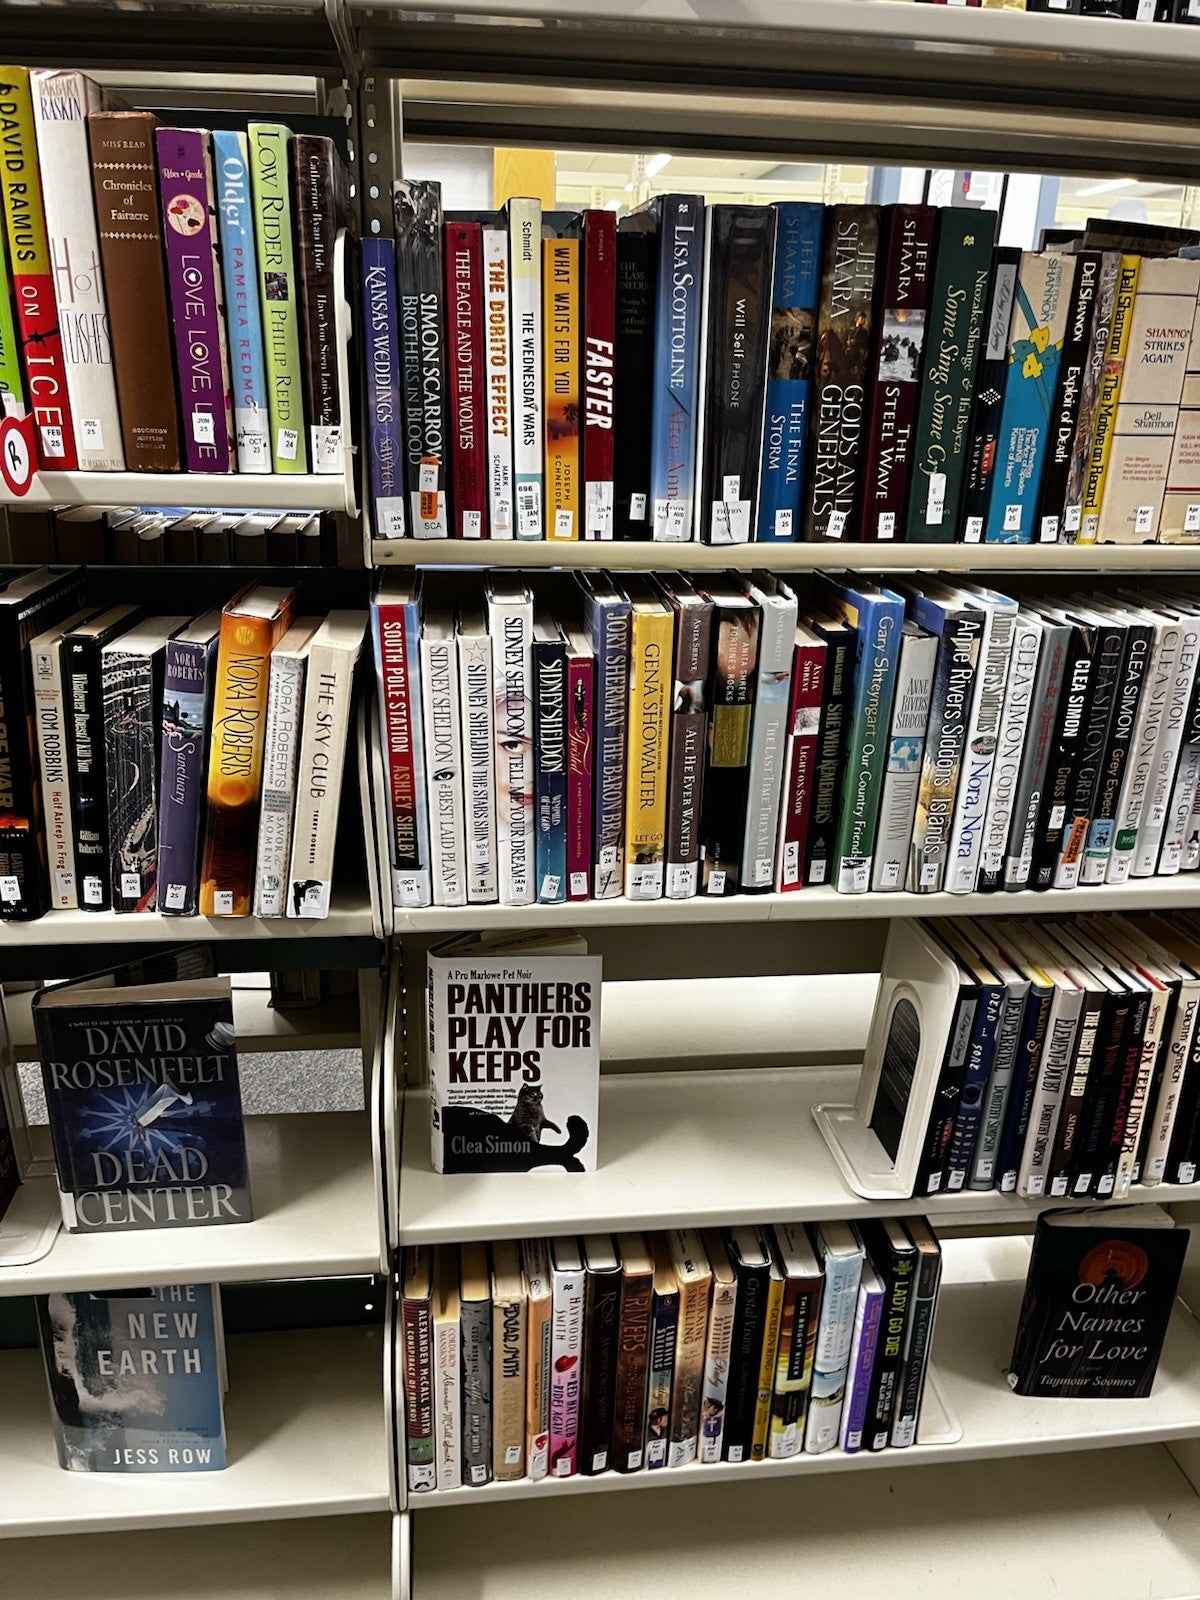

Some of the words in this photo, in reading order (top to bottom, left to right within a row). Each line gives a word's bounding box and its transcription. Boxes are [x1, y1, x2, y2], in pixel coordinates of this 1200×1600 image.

[1, 102, 25, 172] DAVID
[124, 141, 146, 149] READ
[257, 132, 279, 187] LOW
[103, 180, 152, 191] Chronicles
[223, 158, 245, 235] Older
[9, 183, 35, 261] RAMUS
[110, 210, 149, 221] Fairacre
[262, 196, 284, 265] RIDER
[455, 249, 470, 278] THE
[554, 247, 570, 284] WHAT
[674, 225, 694, 269] LISA
[897, 220, 916, 301] SHAARA
[489, 259, 506, 293] THE
[830, 222, 859, 318] SHAARA
[365, 266, 388, 331] KANSAS
[455, 282, 472, 328] EAGLE
[554, 292, 570, 333] WAITS
[271, 310, 287, 367] PHILIP
[489, 301, 507, 367] DORITO
[522, 312, 534, 334] THE
[671, 273, 694, 388] SCOTTOLINE
[457, 332, 473, 362] AND
[554, 340, 570, 363] FOR
[1141, 353, 1173, 363] AGAIN
[1143, 341, 1185, 351] STRIKES
[373, 335, 393, 423] WEDDINGS
[458, 365, 473, 393] THE
[522, 338, 535, 410] WEDNESDAY
[555, 371, 570, 394] YOU
[585, 336, 614, 430] FASTER
[275, 375, 291, 421] REED
[491, 374, 508, 437] EFFECT
[789, 400, 804, 433] THE
[881, 387, 900, 441] STEEL
[459, 395, 474, 450] WOLVES
[523, 413, 535, 446] WARS
[768, 415, 785, 470] STORM
[786, 439, 801, 484] FINAL
[812, 385, 843, 516] GENERALS
[894, 424, 911, 462] THE
[493, 455, 501, 497] SCHATZKER
[875, 447, 894, 499] WAVE
[424, 522, 442, 530] SCA
[174, 652, 196, 667] NORA
[383, 622, 403, 663] SOUTH
[953, 619, 981, 663] Anne
[1014, 633, 1037, 687] CLEA
[1126, 640, 1147, 682] CLEA
[1155, 631, 1178, 685] CLEA
[1178, 632, 1198, 673] CLEA
[168, 664, 203, 680] ROBERTS
[226, 652, 264, 700] NORA
[318, 673, 336, 705] THE
[386, 667, 405, 698] POLE
[430, 646, 451, 696] SIDNEY
[644, 644, 660, 697] GENA
[907, 678, 929, 694] ANNE
[1071, 660, 1091, 692] CLEA
[280, 672, 296, 715] NORA
[901, 695, 928, 712] RIVERS
[944, 668, 973, 720] Rivers
[1115, 685, 1138, 739] SIMON
[1167, 678, 1189, 730] SIMON
[41, 707, 58, 730] TOM
[315, 711, 333, 748] SKY
[389, 702, 408, 753] STATION
[434, 698, 453, 763] SHELDON
[896, 712, 928, 729] SIDDONS
[1002, 692, 1028, 759] SIMON
[1063, 695, 1084, 738] SIMON
[1140, 691, 1165, 757] SIMON
[43, 735, 63, 782] ROBBINS
[215, 706, 260, 778] ROBERTS
[275, 721, 292, 788] ROBERTS
[640, 702, 658, 811] SHOWALTER
[934, 724, 964, 787] Siddons
[310, 753, 329, 798] CLUB
[393, 765, 412, 809] ASHLEY
[961, 760, 991, 809] Nora,
[994, 764, 1016, 809] CODE
[52, 791, 62, 810] Half
[53, 812, 64, 839] Asleep
[57, 840, 65, 850] In
[79, 830, 100, 841] Gillian
[397, 816, 415, 858] SHELBY
[651, 833, 662, 841] GO
[923, 798, 952, 854] Islands
[958, 813, 983, 858] Nora
[987, 809, 1009, 850] GREY
[56, 852, 67, 869] Frog
[78, 843, 103, 854] Roberts
[309, 835, 317, 864] ROBERTS
[447, 971, 453, 980] A
[455, 971, 468, 979] Pru
[470, 970, 501, 979] Marlowe
[503, 970, 515, 979] Pet
[516, 970, 533, 979] Noir
[447, 982, 592, 1015] PANTHERS
[448, 1016, 526, 1050] PLAY
[535, 1016, 591, 1048] FOR
[1147, 1004, 1161, 1035] Simpson
[1180, 1001, 1197, 1041] DOROTHY
[86, 1024, 187, 1056] DAVID
[1140, 1040, 1156, 1065] SIX
[50, 1054, 229, 1090] ROSENFELT
[449, 1051, 541, 1084] KEEPS
[1172, 1042, 1187, 1083] SIMPSON
[1133, 1068, 1150, 1102] FEET
[451, 1135, 483, 1154] Clea
[485, 1134, 531, 1154] Simon
[1120, 1105, 1143, 1154] UNDER
[91, 1147, 209, 1187] DEAD
[76, 1184, 242, 1228] CENTER
[159, 1285, 196, 1302] THE
[800, 1296, 808, 1315] THIS
[1072, 1283, 1146, 1305] Other
[127, 1313, 198, 1339] NEW
[555, 1310, 567, 1340] SMITH
[568, 1297, 581, 1350] HAYWOOD
[623, 1296, 648, 1352] RIVERS
[796, 1319, 805, 1350] BRIGHT
[1057, 1311, 1145, 1333] Names
[97, 1349, 202, 1375] EARTH
[407, 1330, 416, 1377] CONSPIRACY
[793, 1351, 801, 1376] RIVER
[1039, 1339, 1083, 1364] for
[1088, 1340, 1148, 1360] Love
[409, 1379, 416, 1389] OF
[567, 1380, 578, 1398] RED
[1040, 1375, 1091, 1388] Taymour
[1092, 1375, 1136, 1387] Soomro
[409, 1392, 417, 1423] FRIENDS
[566, 1417, 577, 1438] CLUB
[567, 1400, 578, 1415] HAT
[113, 1448, 159, 1465] JESS
[169, 1448, 212, 1464] ROW
